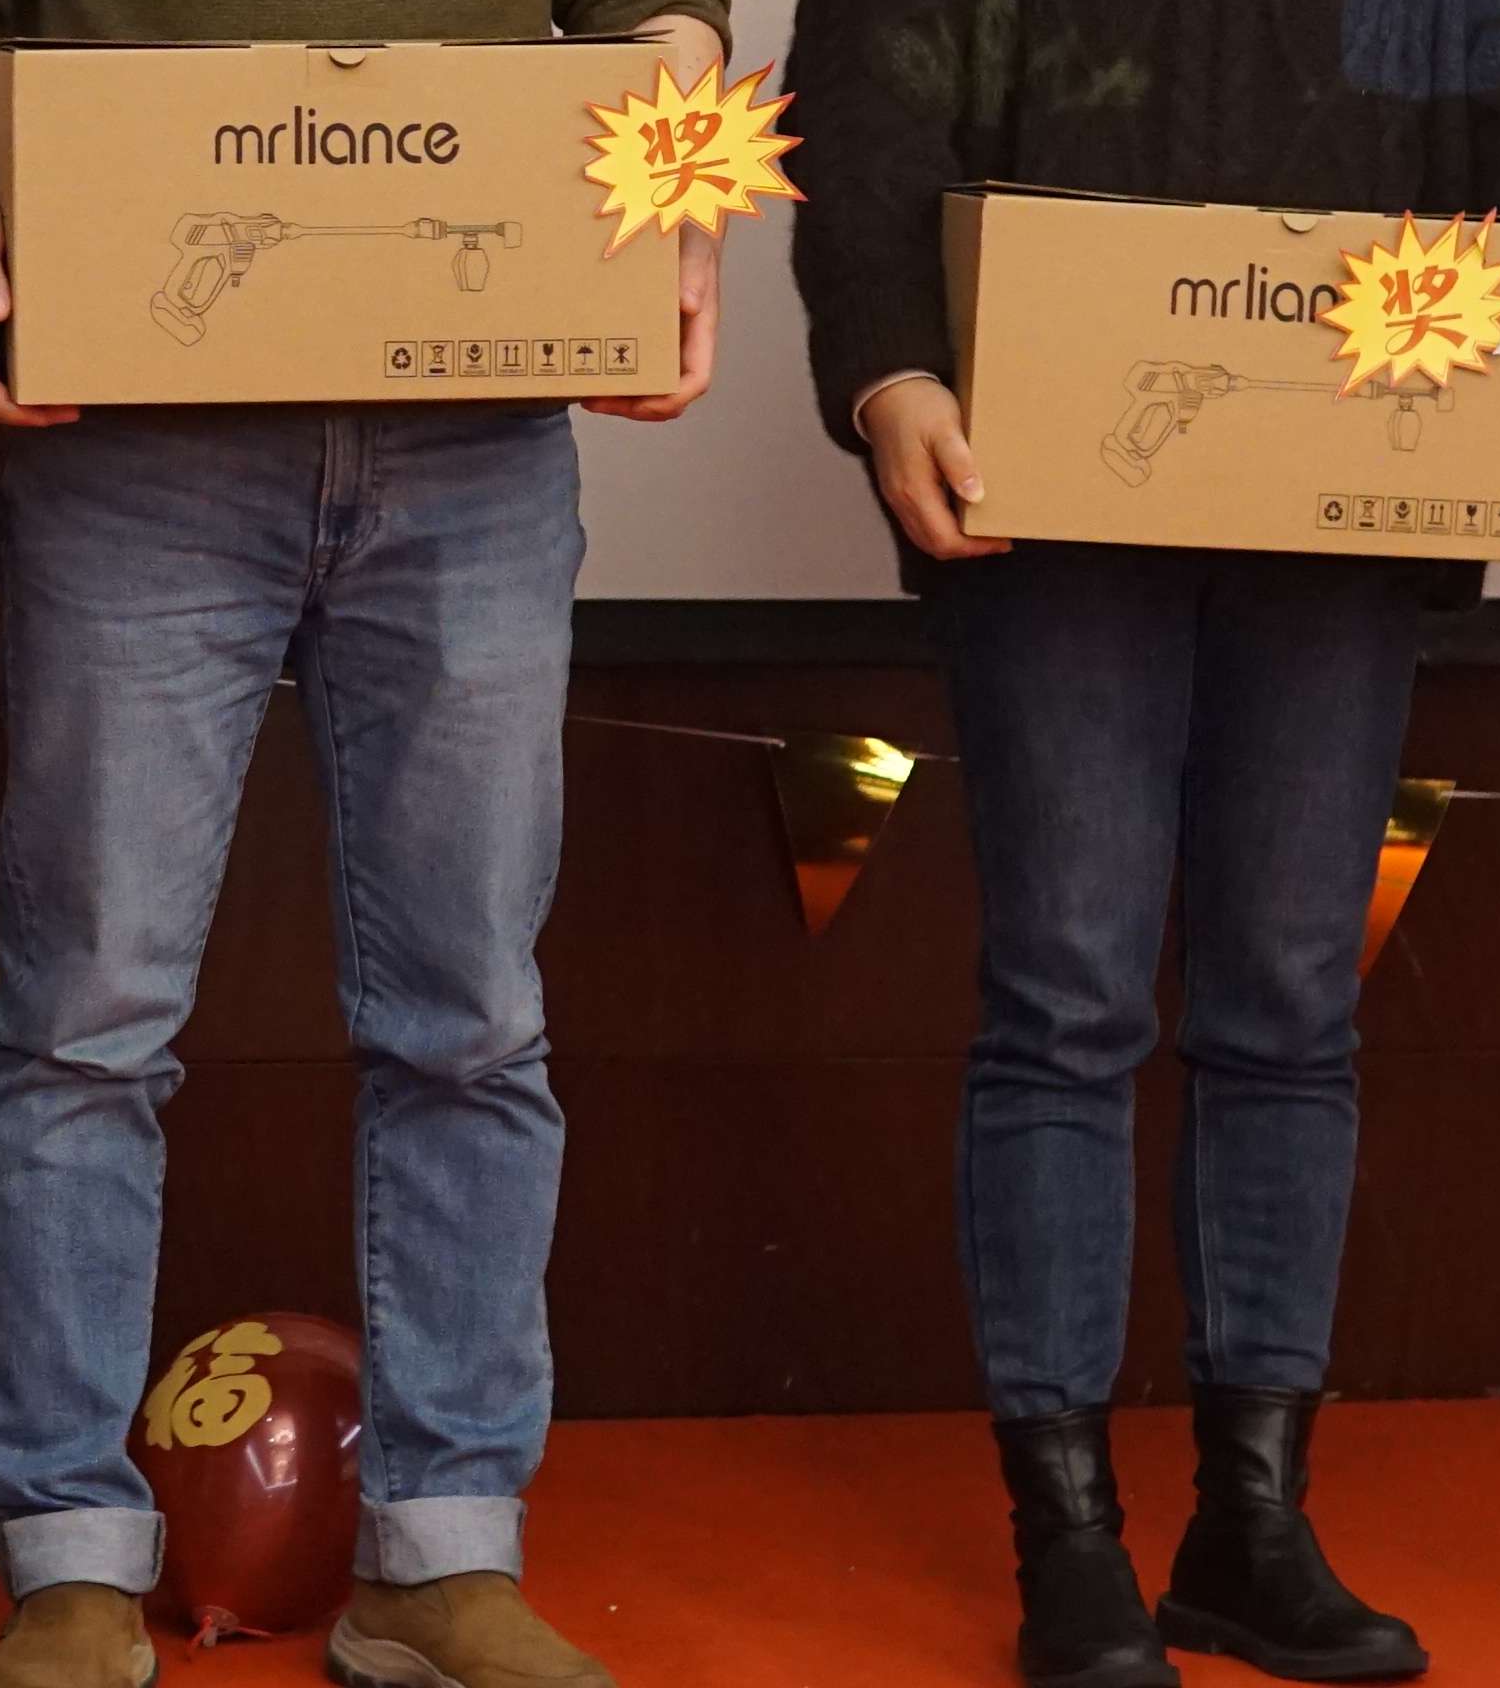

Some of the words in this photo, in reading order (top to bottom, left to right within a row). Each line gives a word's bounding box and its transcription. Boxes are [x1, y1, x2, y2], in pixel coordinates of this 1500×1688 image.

[213, 104, 461, 167] mrliance
[638, 111, 738, 208] 奖
[1170, 262, 1340, 323] mrlian
[1378, 265, 1468, 356] 奖
[143, 1320, 284, 1450] 福
